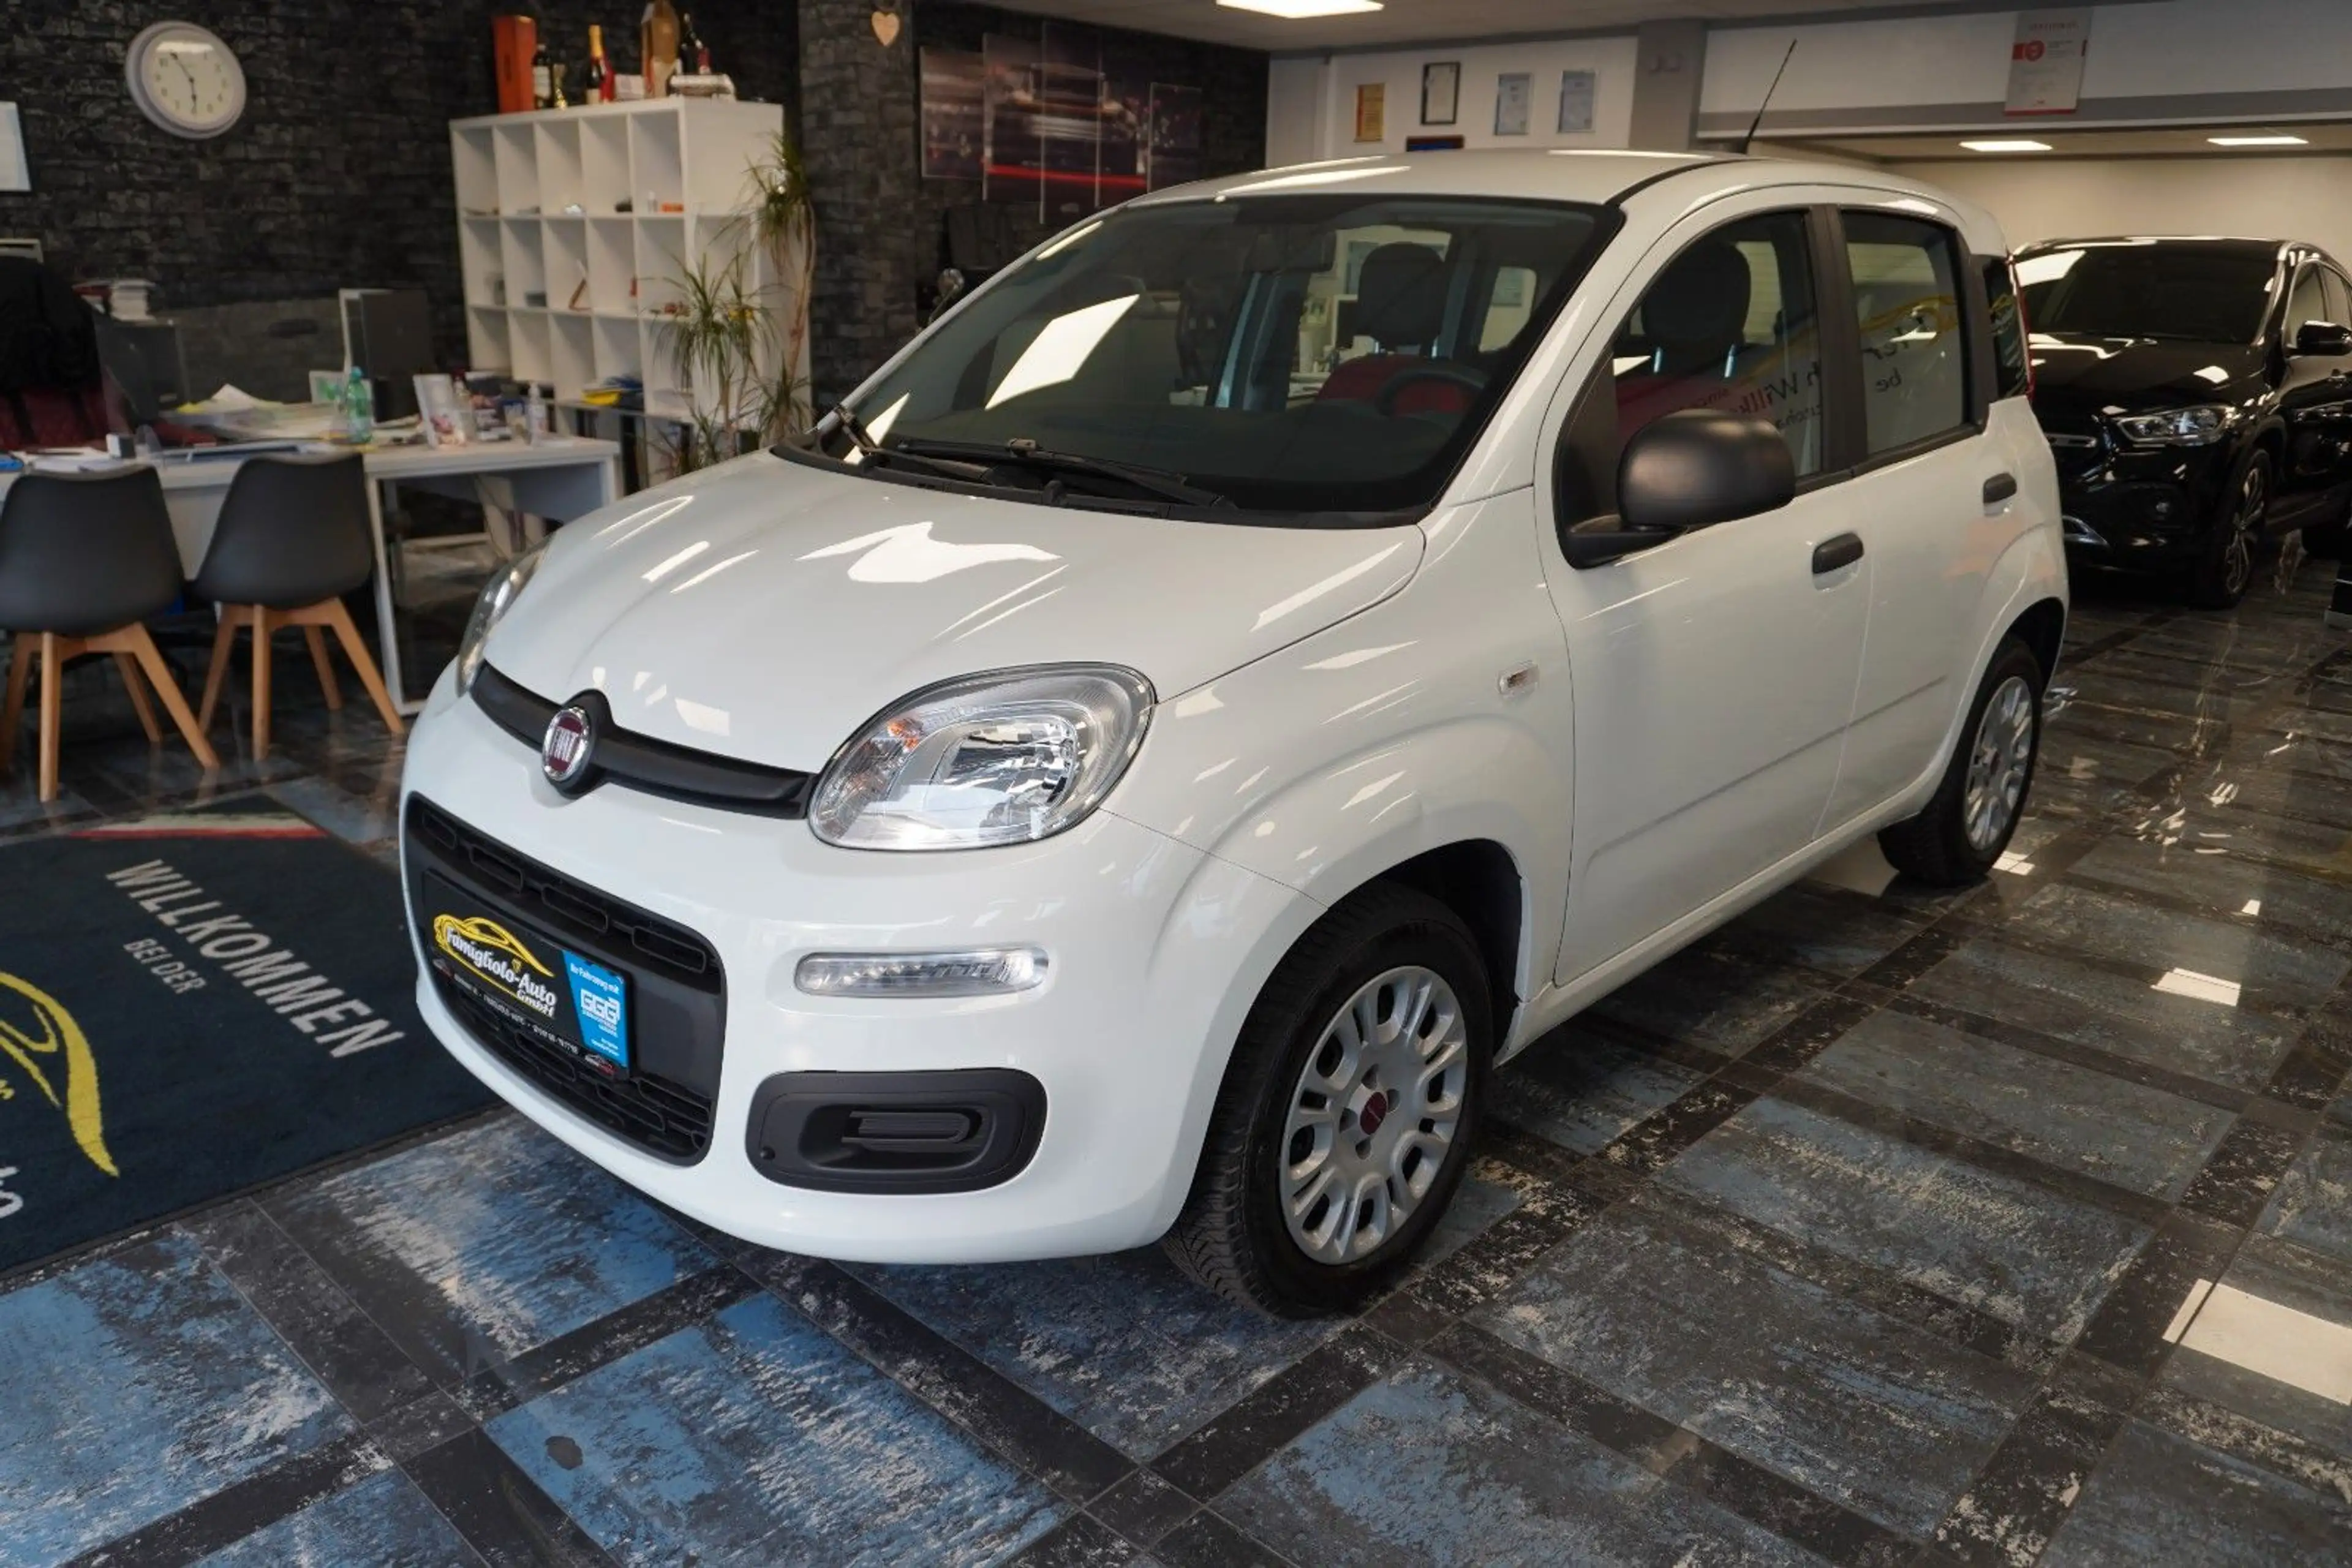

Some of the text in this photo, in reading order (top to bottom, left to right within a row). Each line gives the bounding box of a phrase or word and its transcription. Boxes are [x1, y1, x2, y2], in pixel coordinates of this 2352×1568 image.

[106, 859, 405, 1058] WILLKOMMEN
[124, 938, 206, 994] BEI DER
